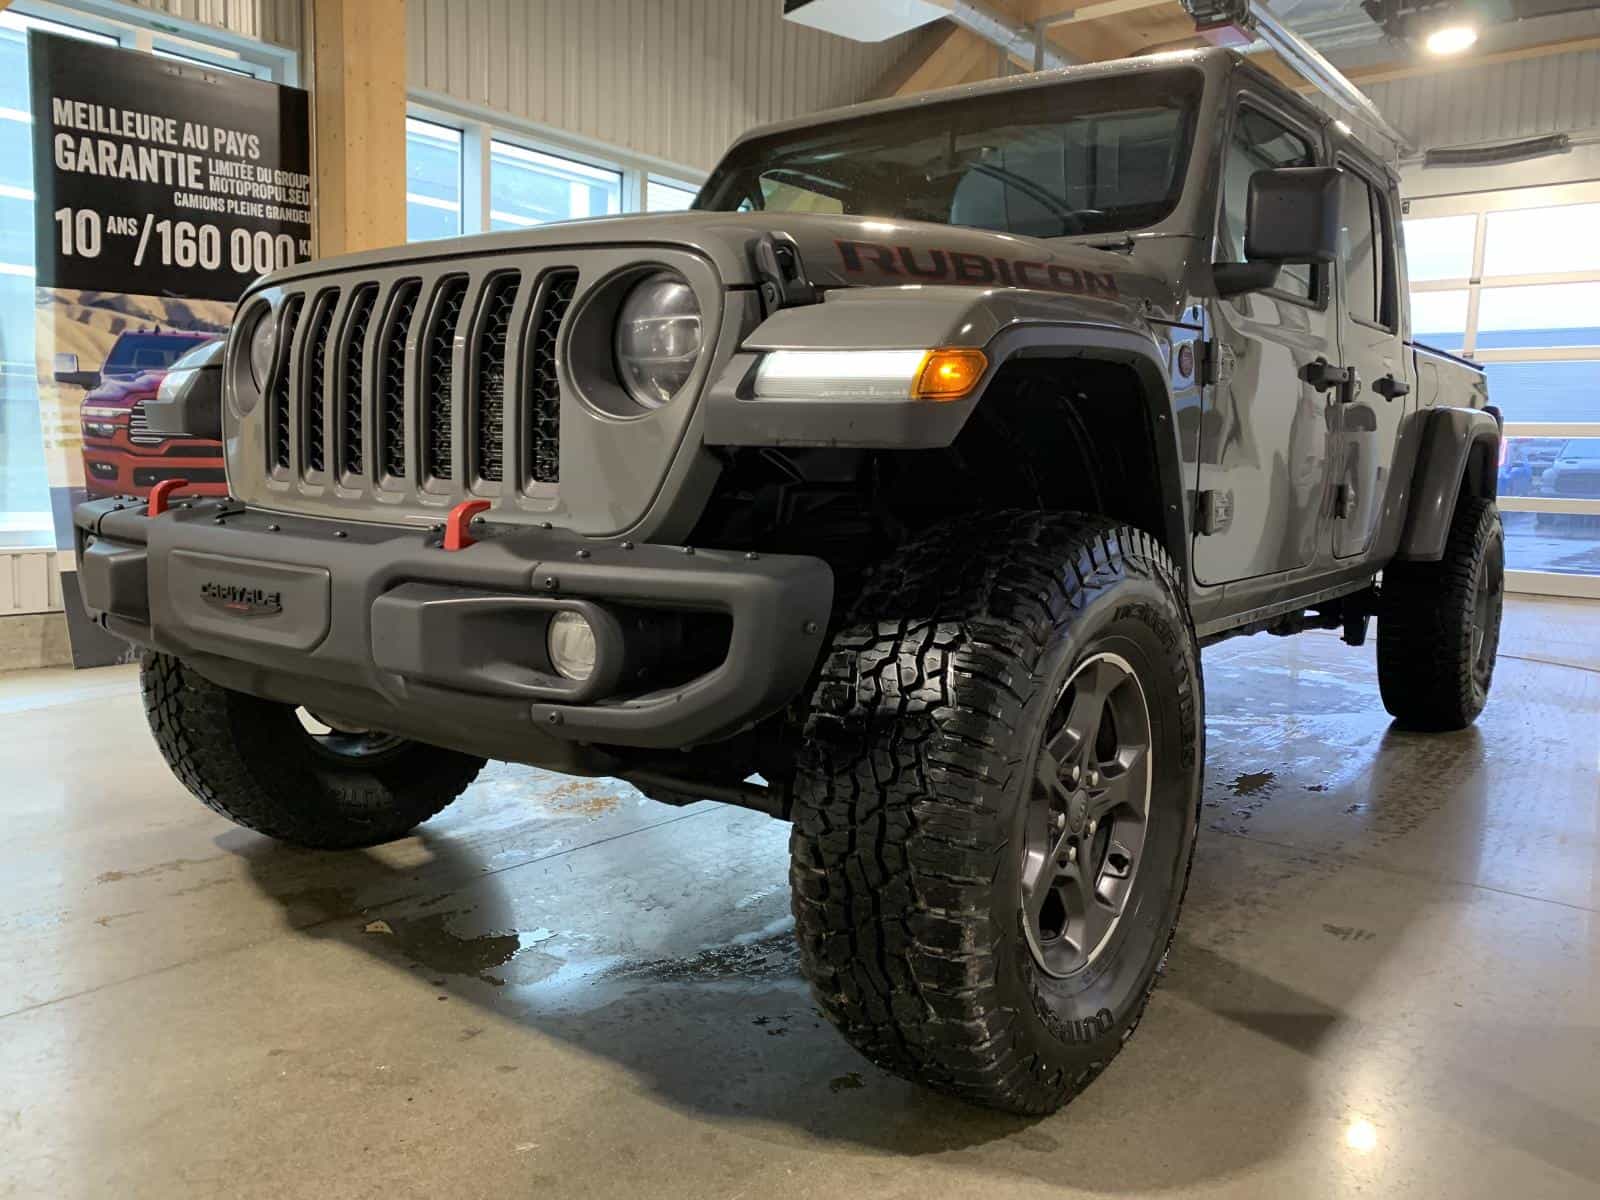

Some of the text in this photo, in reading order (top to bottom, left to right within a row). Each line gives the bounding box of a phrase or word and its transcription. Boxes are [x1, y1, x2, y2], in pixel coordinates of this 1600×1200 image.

[53, 97, 260, 160] MEILLEURE AU PAYS
[54, 132, 205, 190] GARANTIE
[208, 157, 309, 190] LIMITÉE DU GROUP
[173, 191, 311, 224] CAMIONS PLEINE GRANDEU
[209, 175, 309, 206] MOTOPROPULSEU
[55, 207, 102, 258] 10
[106, 215, 138, 237] ANS
[231, 227, 295, 275] 000
[834, 238, 1119, 298] RUBICON
